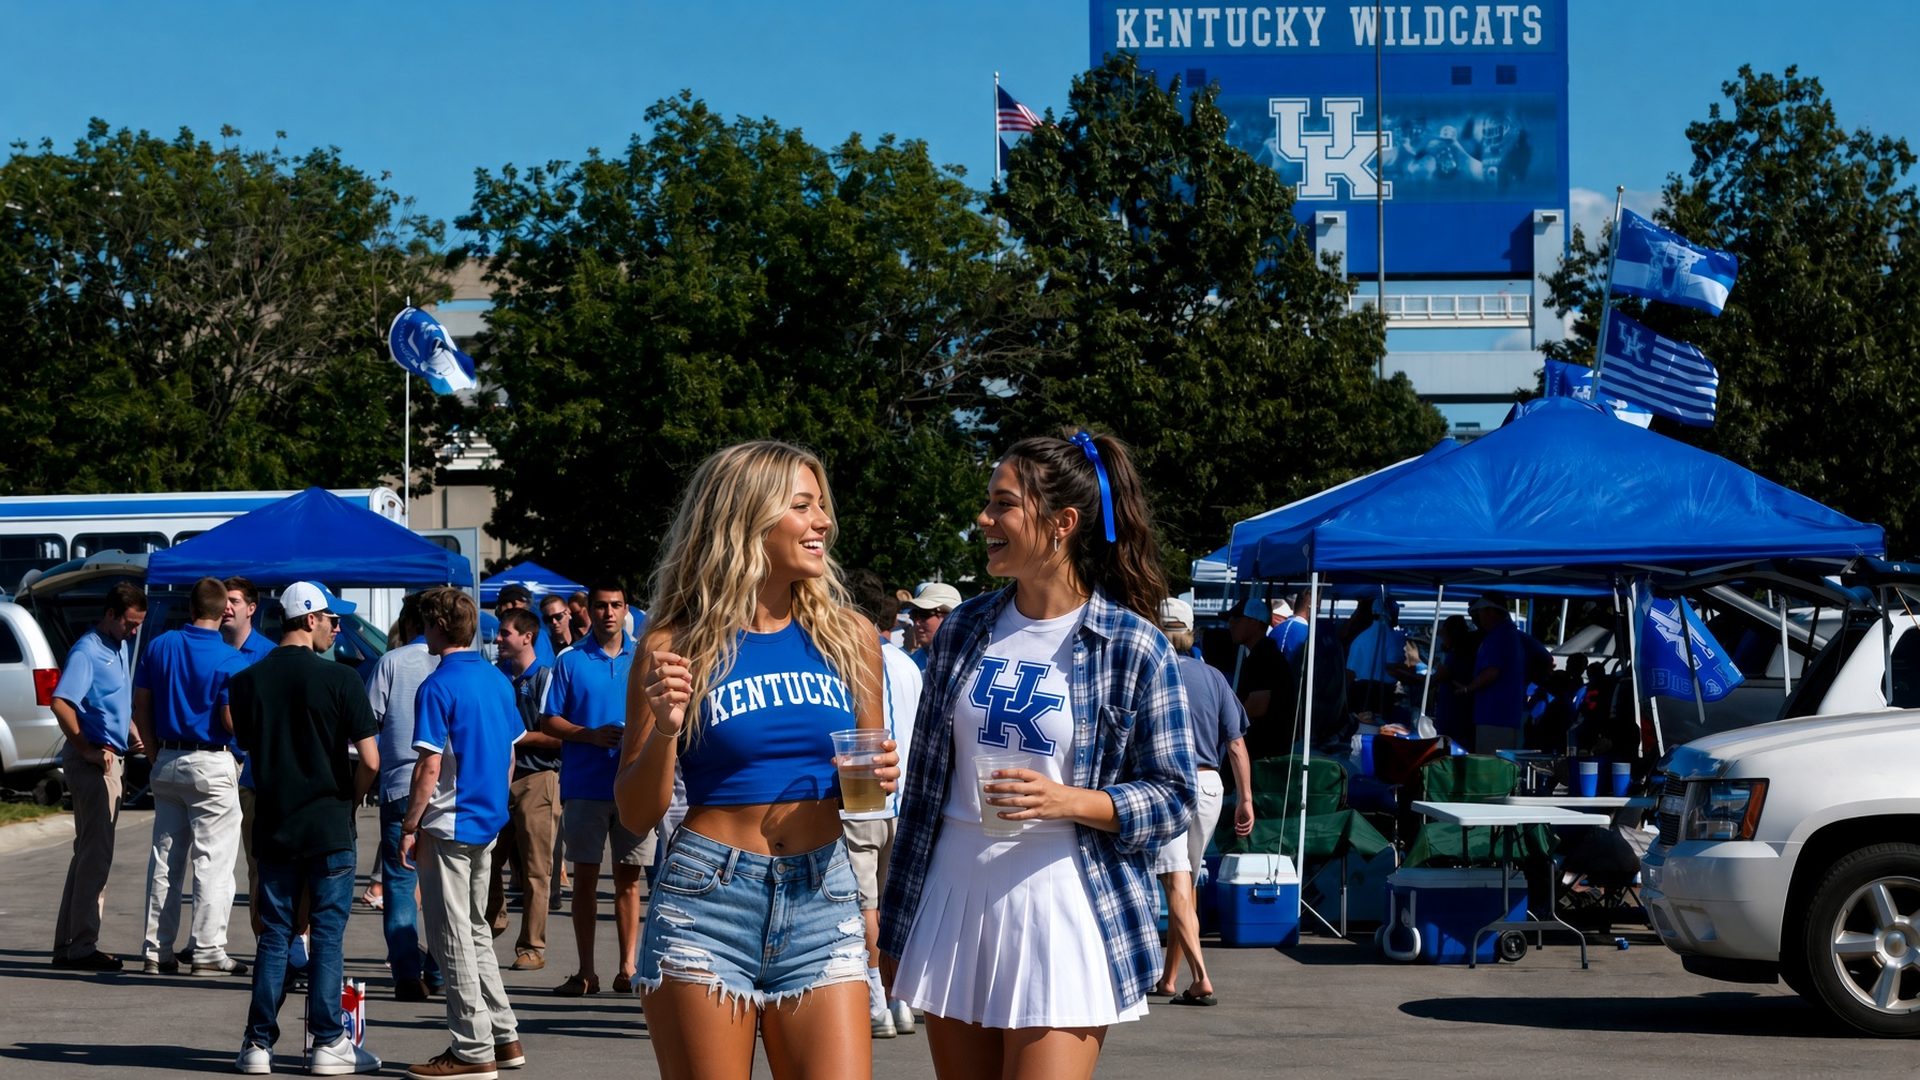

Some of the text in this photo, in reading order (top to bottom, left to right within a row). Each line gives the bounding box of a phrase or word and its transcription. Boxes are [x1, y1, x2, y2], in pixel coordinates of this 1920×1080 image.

[1117, 5, 1542, 48] KENTUCKY WILDCATS
[1269, 97, 1393, 201] UK
[1618, 321, 1646, 363] UK
[708, 671, 851, 727] KENTUCKY
[969, 656, 1065, 757] UK
